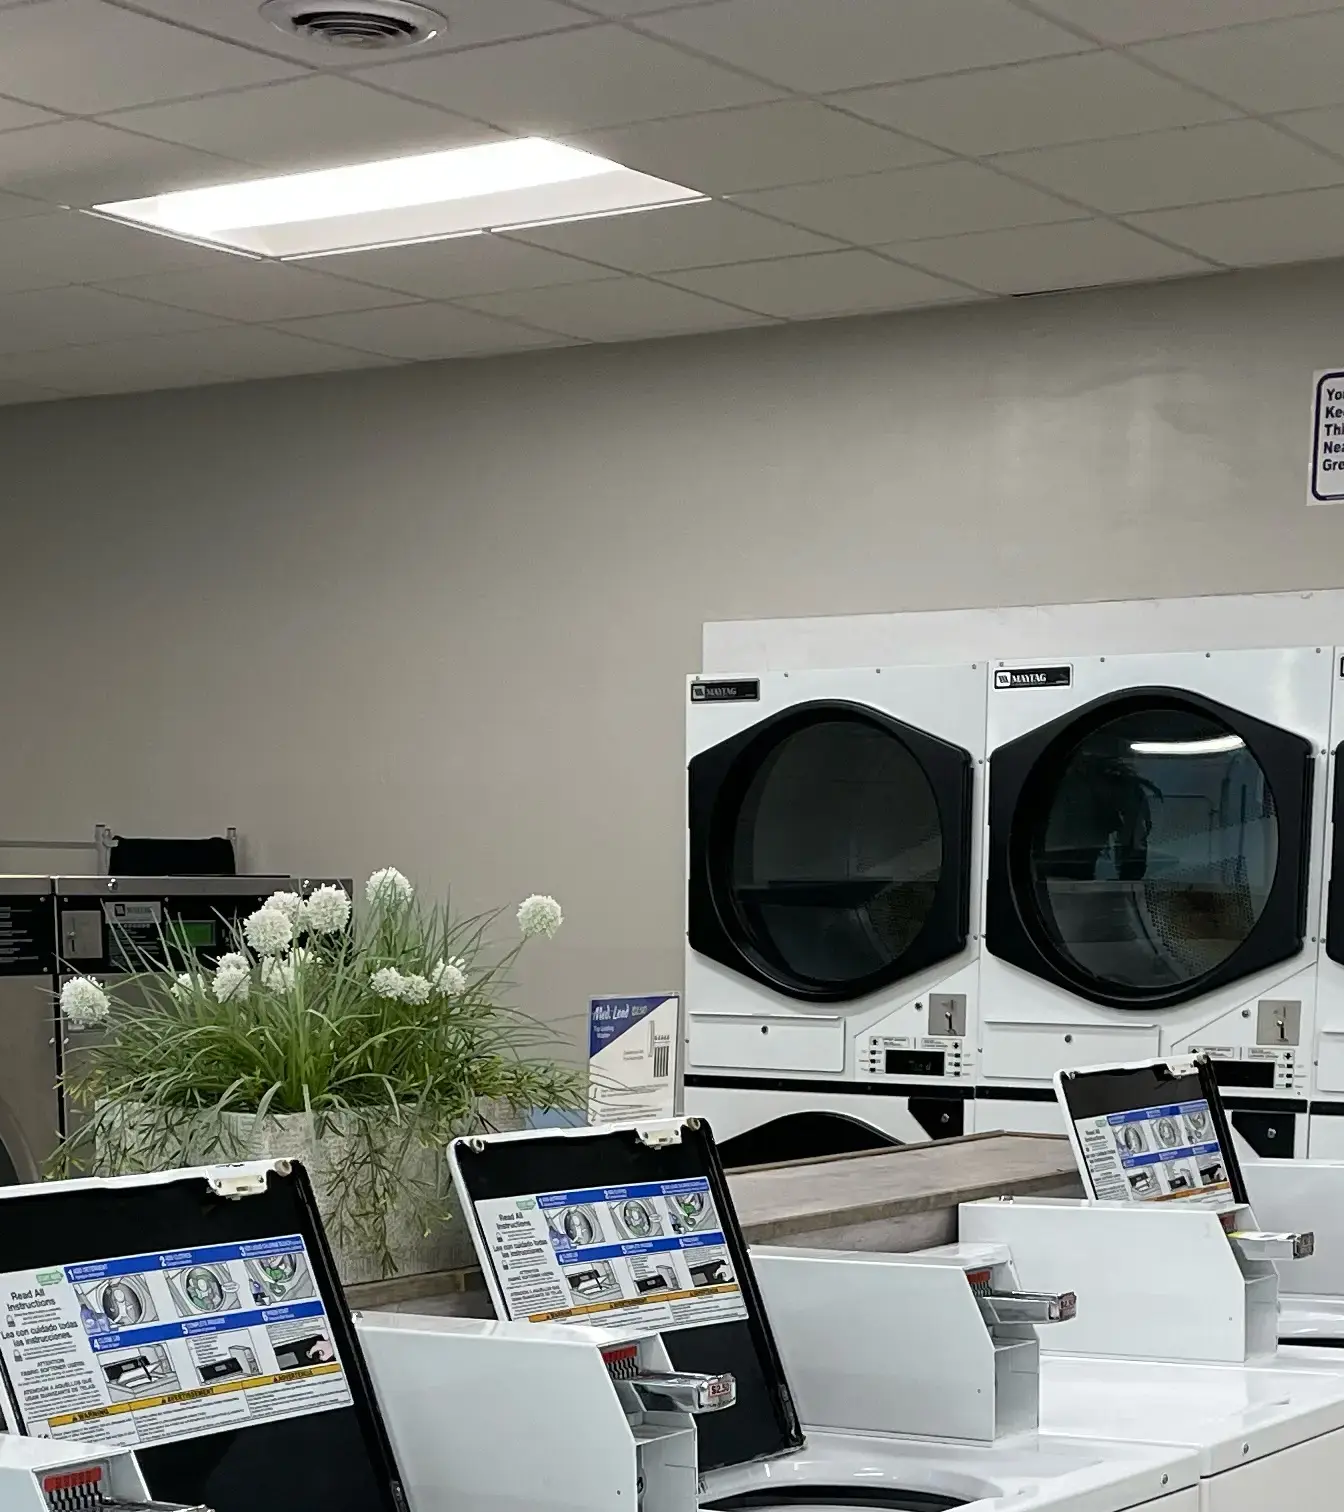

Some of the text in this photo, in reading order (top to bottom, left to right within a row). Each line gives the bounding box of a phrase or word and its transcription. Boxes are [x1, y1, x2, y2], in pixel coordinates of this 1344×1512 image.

[1012, 673, 1047, 683] MAYTAG
[706, 687, 737, 696] MAYTAG
[159, 1256, 166, 1267] 2
[68, 1269, 74, 1280] 1
[10, 1288, 45, 1300] Read All
[7, 1299, 56, 1311] Instructions
[1, 1321, 78, 1339] Lea con cuidado todas
[181, 1323, 188, 1335] 5
[93, 1339, 100, 1350] 4
